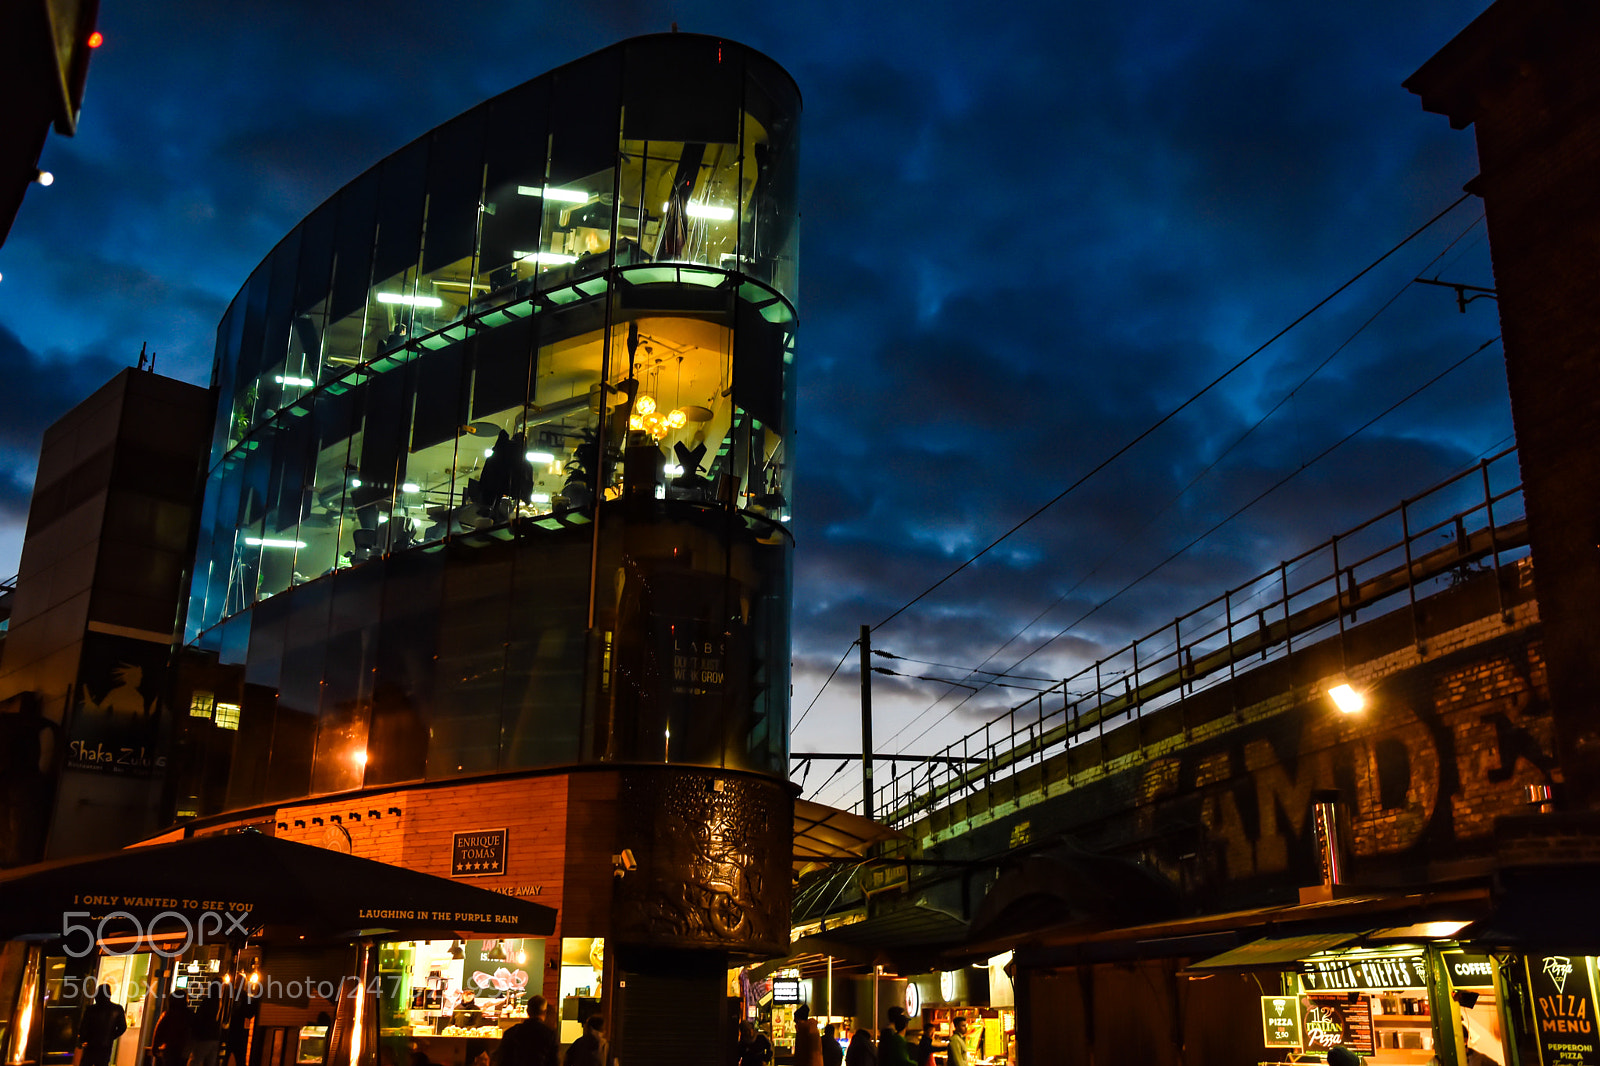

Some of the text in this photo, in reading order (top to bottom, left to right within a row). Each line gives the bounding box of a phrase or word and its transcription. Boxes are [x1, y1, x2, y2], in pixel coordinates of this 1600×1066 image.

[69, 740, 113, 763] Shaka
[457, 835, 501, 848] ENRIQUE
[461, 848, 496, 860] TOMAS
[515, 885, 542, 896] AWAY
[73, 895, 255, 913] I ONLY WANTED TO SEE YOU
[359, 909, 519, 924] LAUGHING IN THE PURPLE RAIN
[1455, 963, 1492, 976] COFFEE
[1542, 957, 1573, 975] Pizza
[1318, 960, 1358, 988] PIZZA
[1538, 994, 1586, 1019] PIZZA
[1268, 1017, 1294, 1027] PIZZA
[1306, 1022, 1343, 1033] ITALIAN
[1542, 1019, 1591, 1034] MENU
[1307, 1027, 1342, 1047] Pizza
[1547, 1043, 1593, 1053] PEPPERONI
[1559, 1052, 1584, 1060] PIZZA
